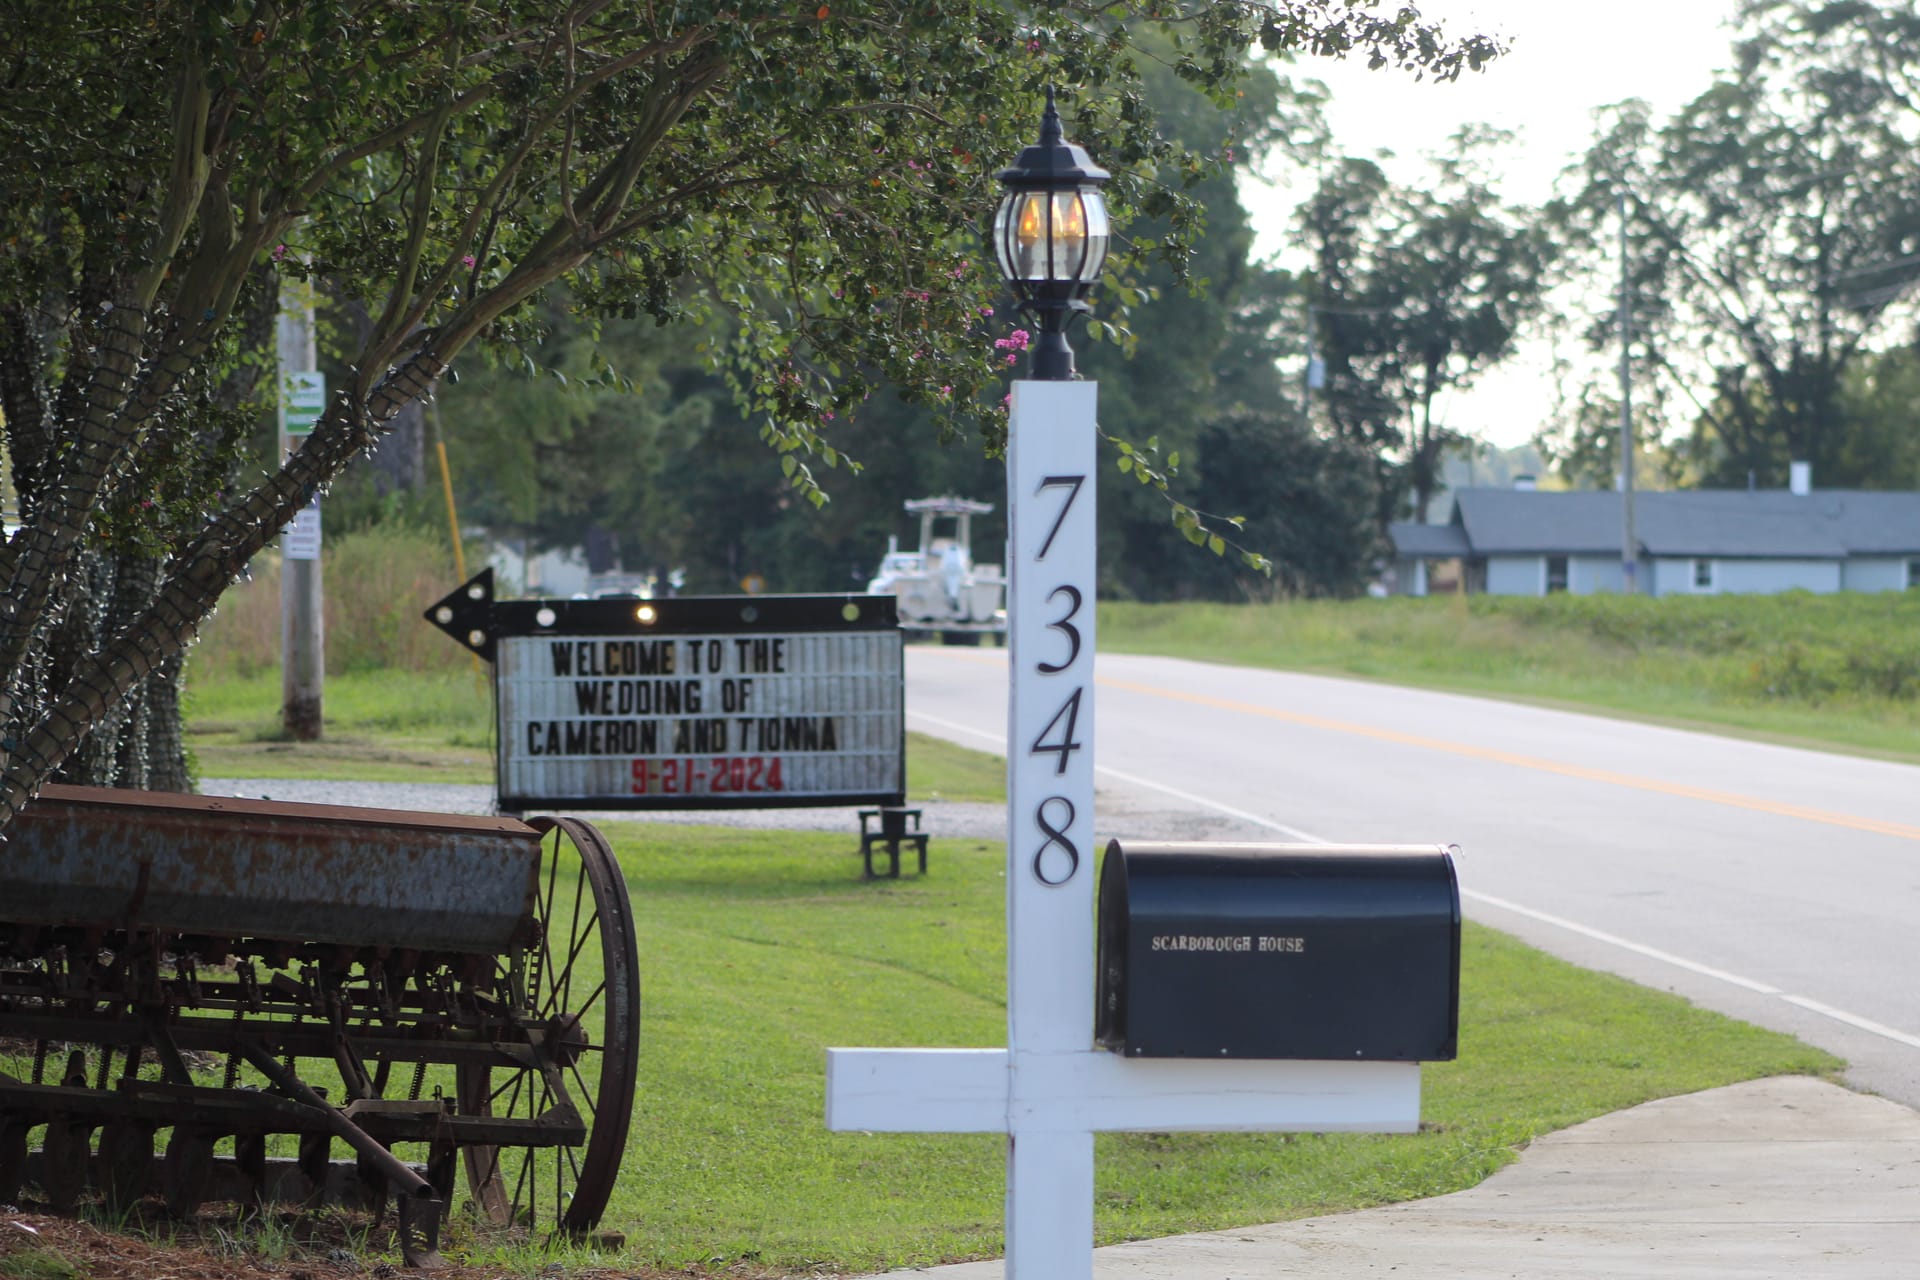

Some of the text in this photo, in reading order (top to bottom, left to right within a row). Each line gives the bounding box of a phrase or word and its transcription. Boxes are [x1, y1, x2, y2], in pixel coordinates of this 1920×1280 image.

[551, 638, 785, 677] WELCOME TO THE
[575, 678, 753, 715] WEDDING OF
[1029, 475, 1087, 887] 7348
[528, 716, 837, 755] CAMERON AND TIONNA
[631, 756, 784, 794] 9-21-2024
[1152, 935, 1305, 953] SCARBOROUGH HOUSE
